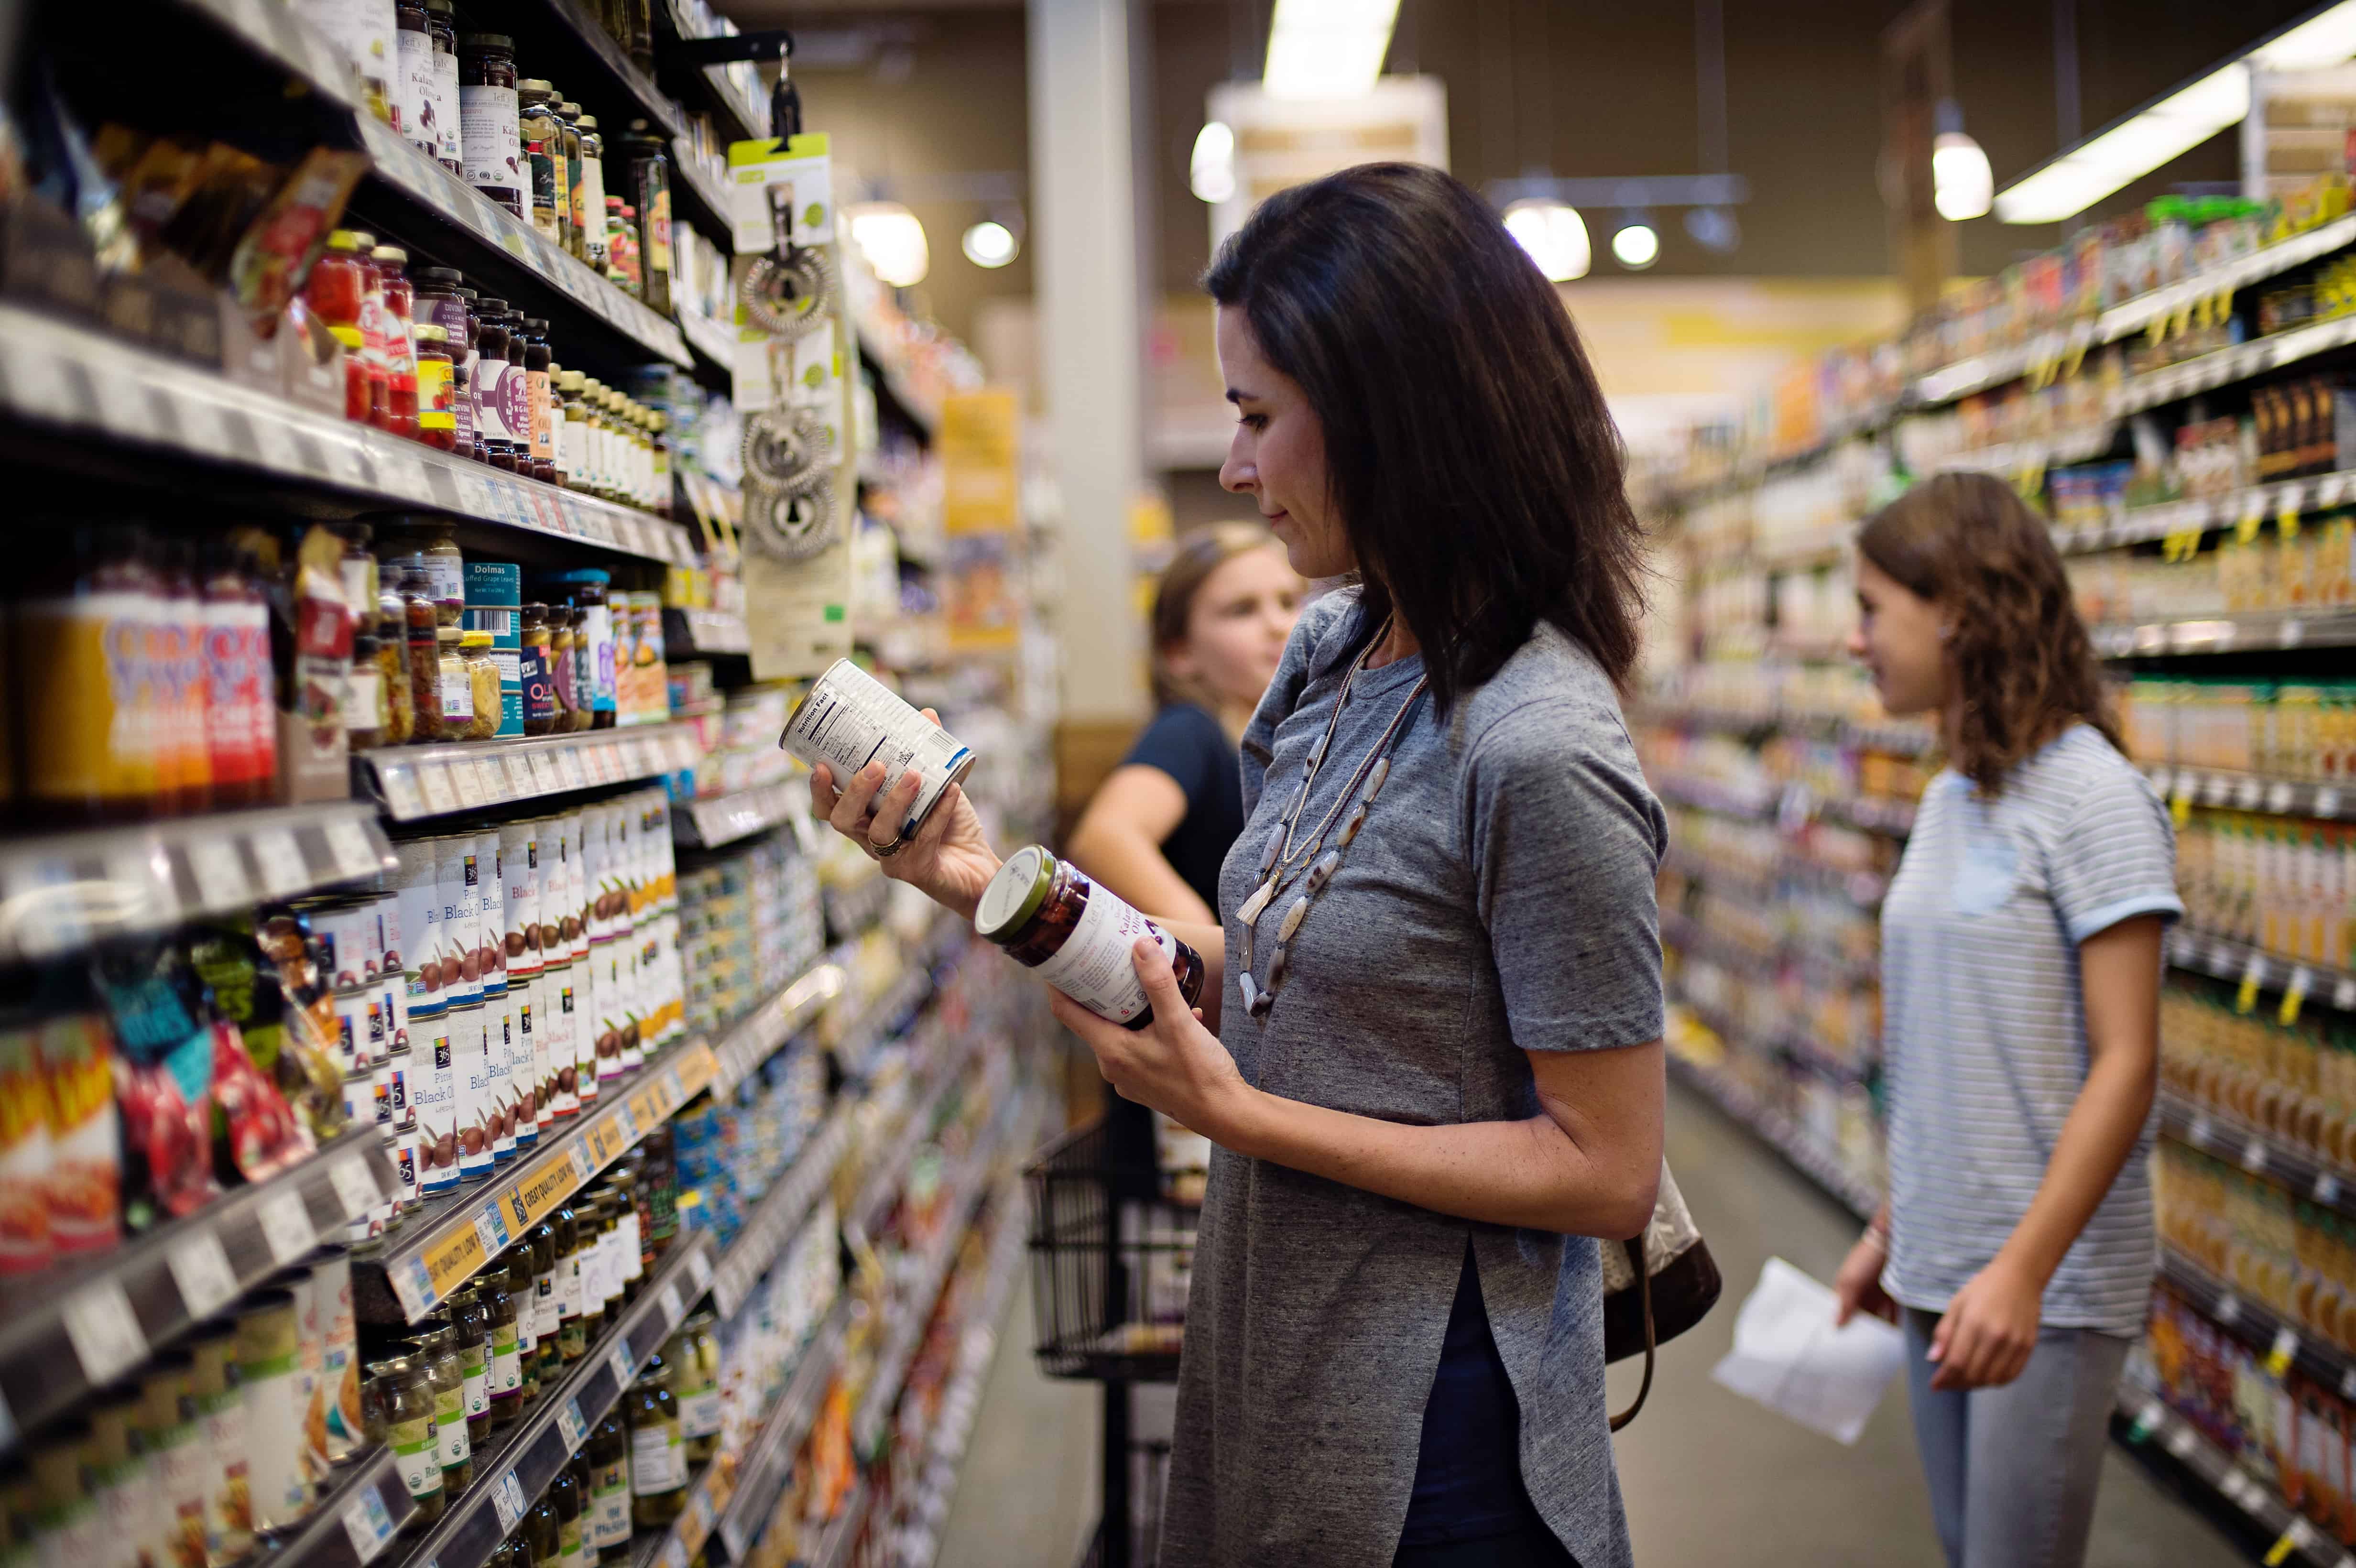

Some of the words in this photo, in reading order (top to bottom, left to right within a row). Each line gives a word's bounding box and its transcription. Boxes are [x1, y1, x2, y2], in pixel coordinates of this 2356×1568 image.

[475, 565, 505, 574] Dolmas
[797, 707, 818, 734] Nutrition
[816, 693, 829, 708] Fact
[464, 888, 478, 900] Pitte
[445, 903, 474, 919] Black
[438, 1047, 450, 1063] 365
[513, 1049, 528, 1065] lack
[435, 1072, 453, 1084] Pitte
[414, 1086, 446, 1105] Black
[524, 1187, 540, 1208] GREAT
[425, 1464, 440, 1478] Reli
